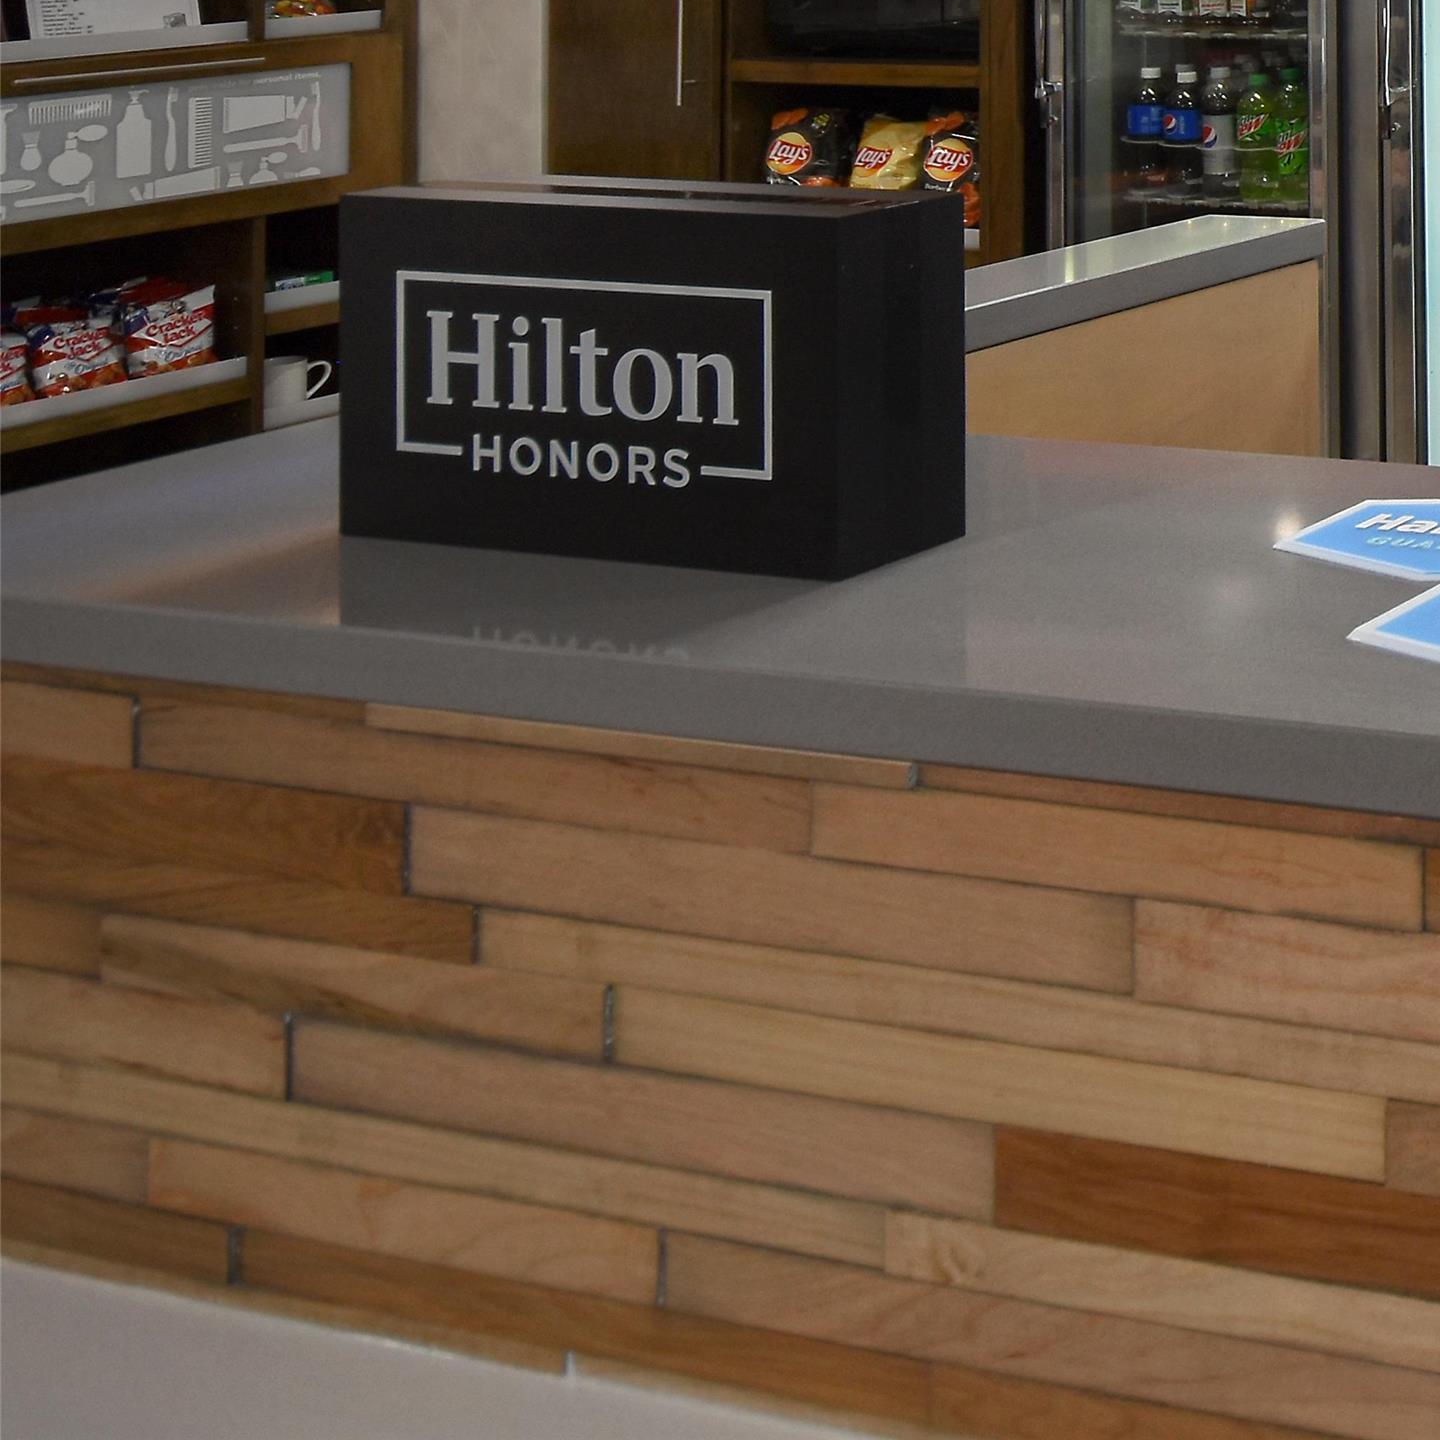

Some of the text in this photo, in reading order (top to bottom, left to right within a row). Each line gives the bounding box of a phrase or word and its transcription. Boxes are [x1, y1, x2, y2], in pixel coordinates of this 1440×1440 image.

[769, 141, 809, 164] Lay's
[854, 148, 890, 169] Lay's
[927, 150, 969, 172] Lay's
[426, 310, 739, 425] Hilton
[472, 433, 691, 489] HONORS
